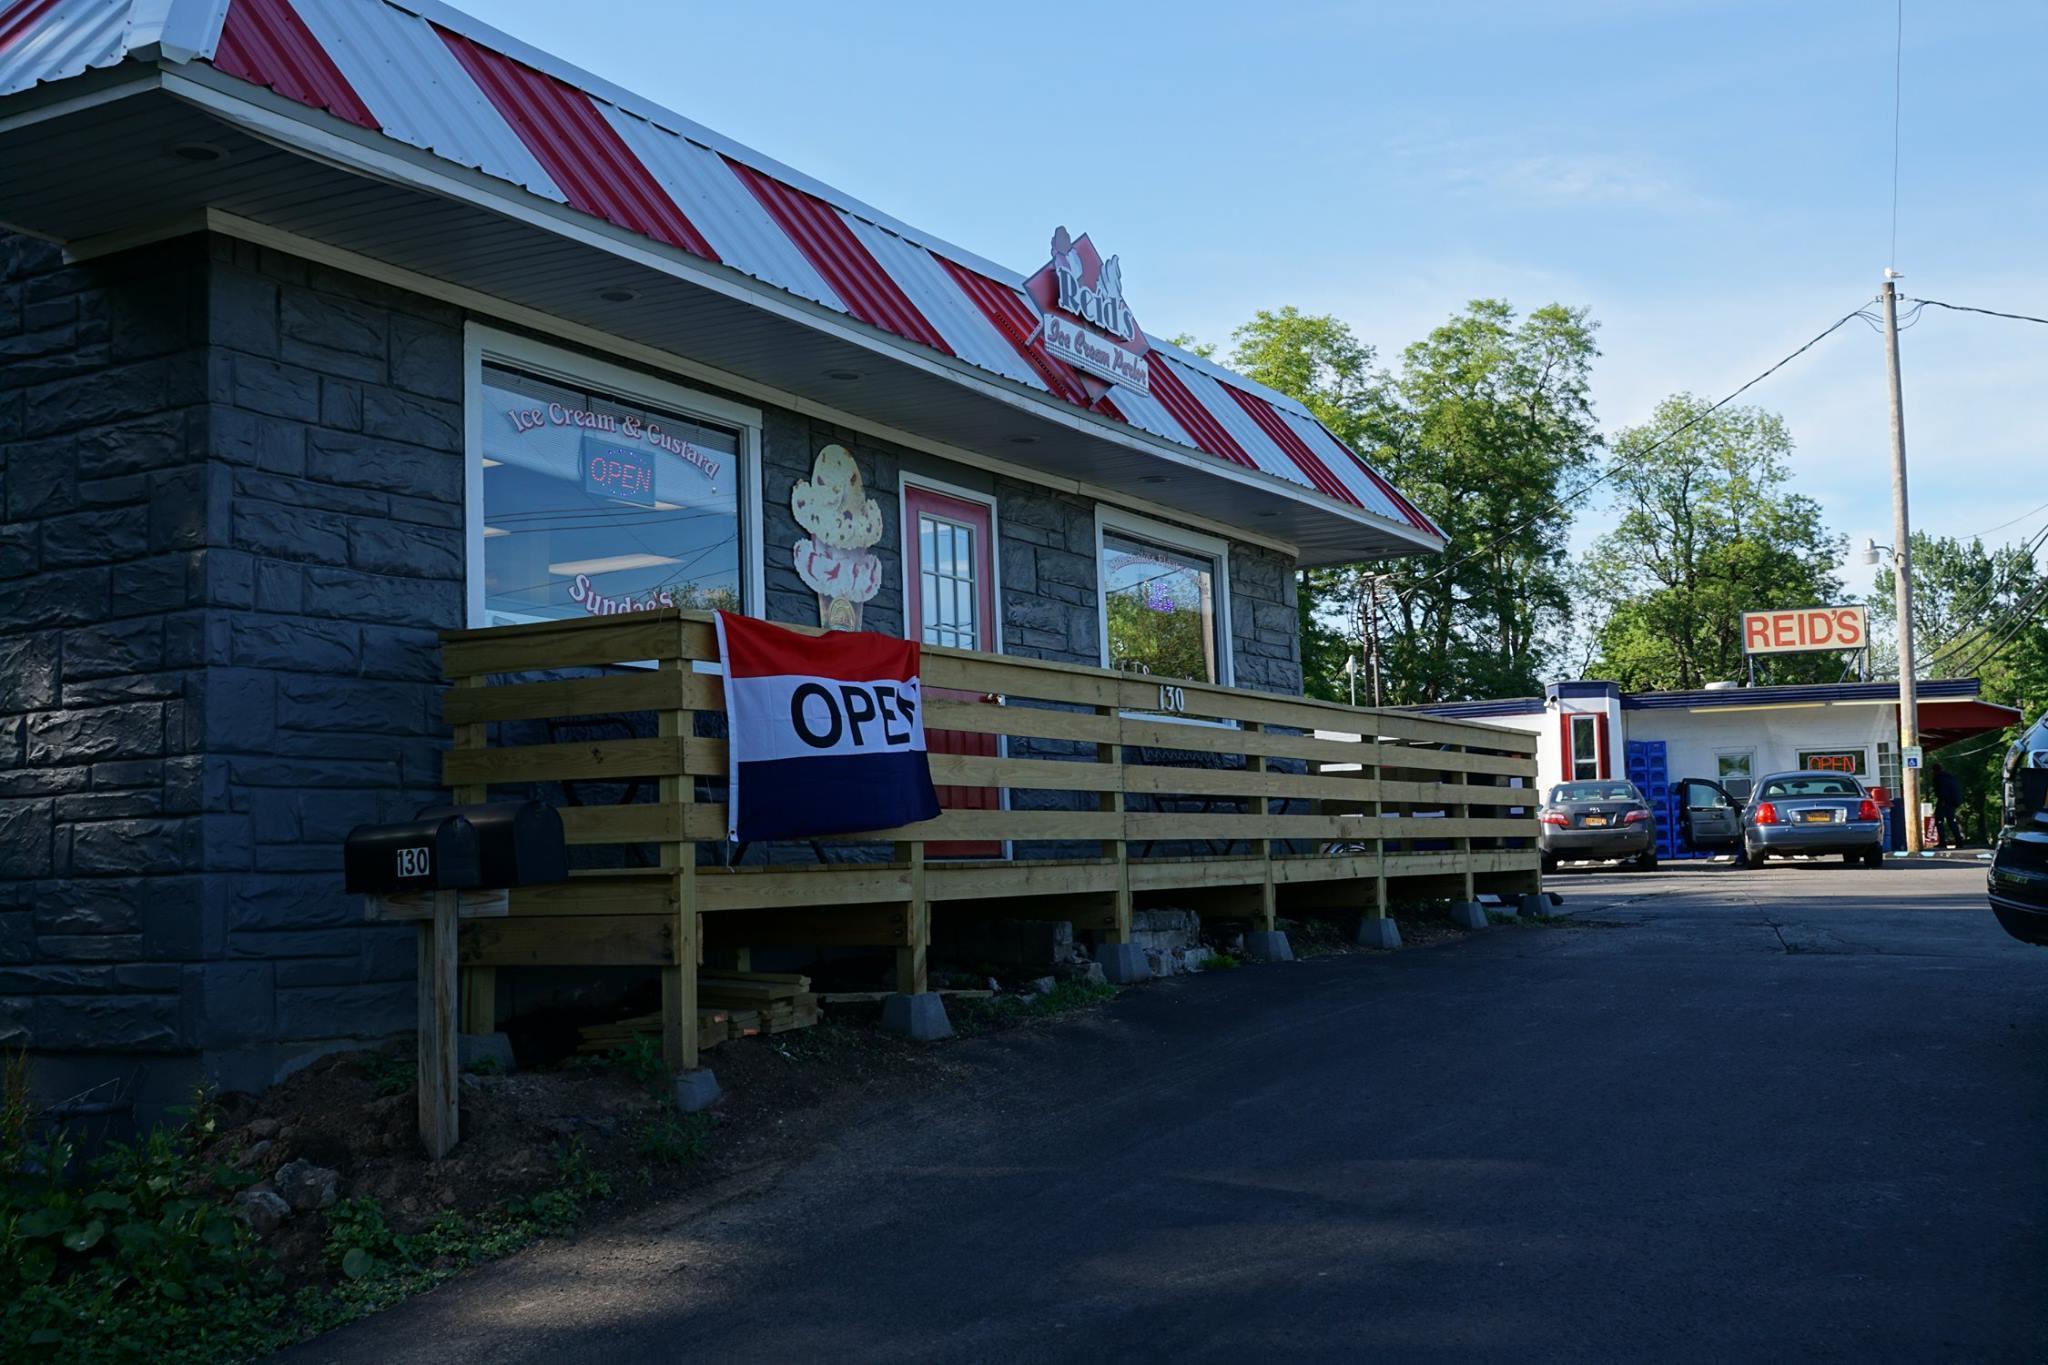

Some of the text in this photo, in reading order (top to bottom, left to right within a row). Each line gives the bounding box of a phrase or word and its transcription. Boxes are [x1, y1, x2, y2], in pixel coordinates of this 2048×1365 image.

[1058, 268, 1134, 340] Reid's
[508, 401, 720, 480] Ice Cream & Custard
[591, 456, 652, 493] OPEN
[1746, 609, 1860, 649] REID'S
[1159, 684, 1184, 712] 130
[1809, 756, 1855, 773] OPEN
[398, 848, 428, 876] 130
